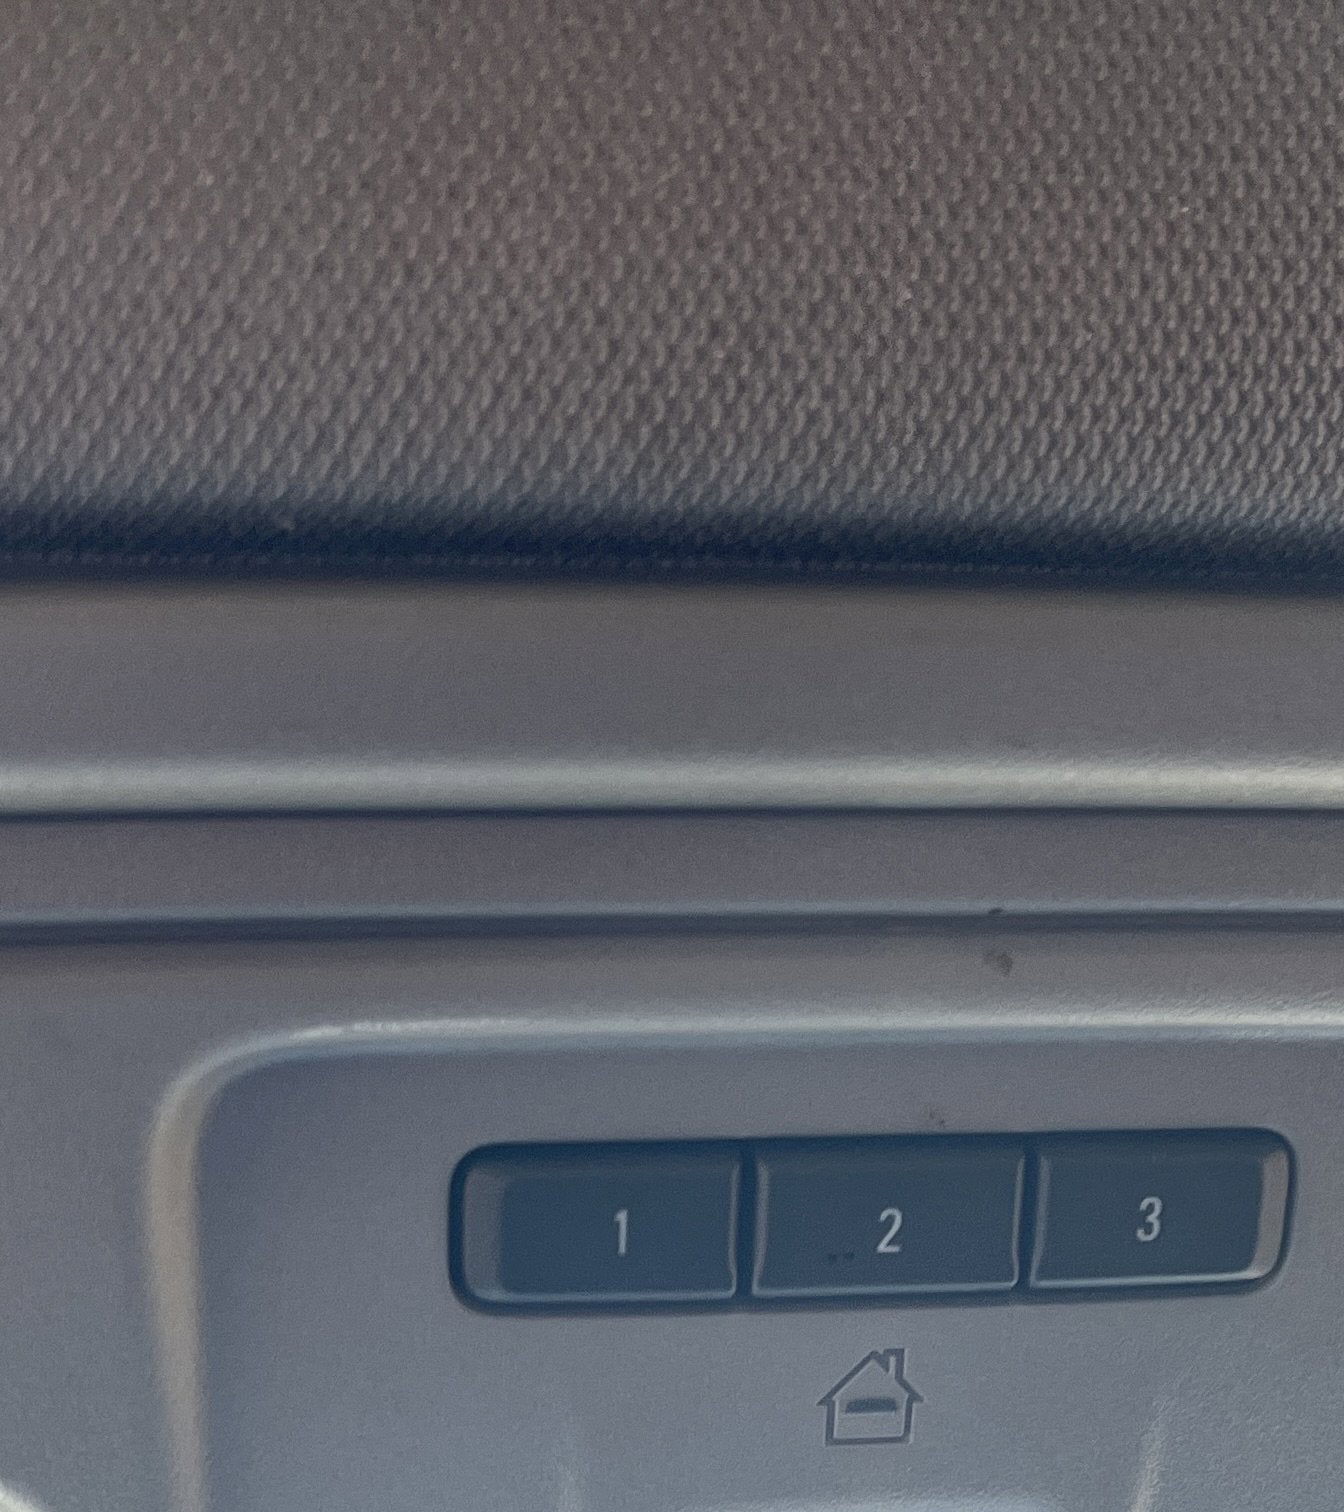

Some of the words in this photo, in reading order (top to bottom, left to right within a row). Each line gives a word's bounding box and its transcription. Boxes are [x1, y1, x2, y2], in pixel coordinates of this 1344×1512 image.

[612, 1207, 628, 1255] 1
[875, 1207, 904, 1254] 2
[1134, 1196, 1163, 1242] 3
